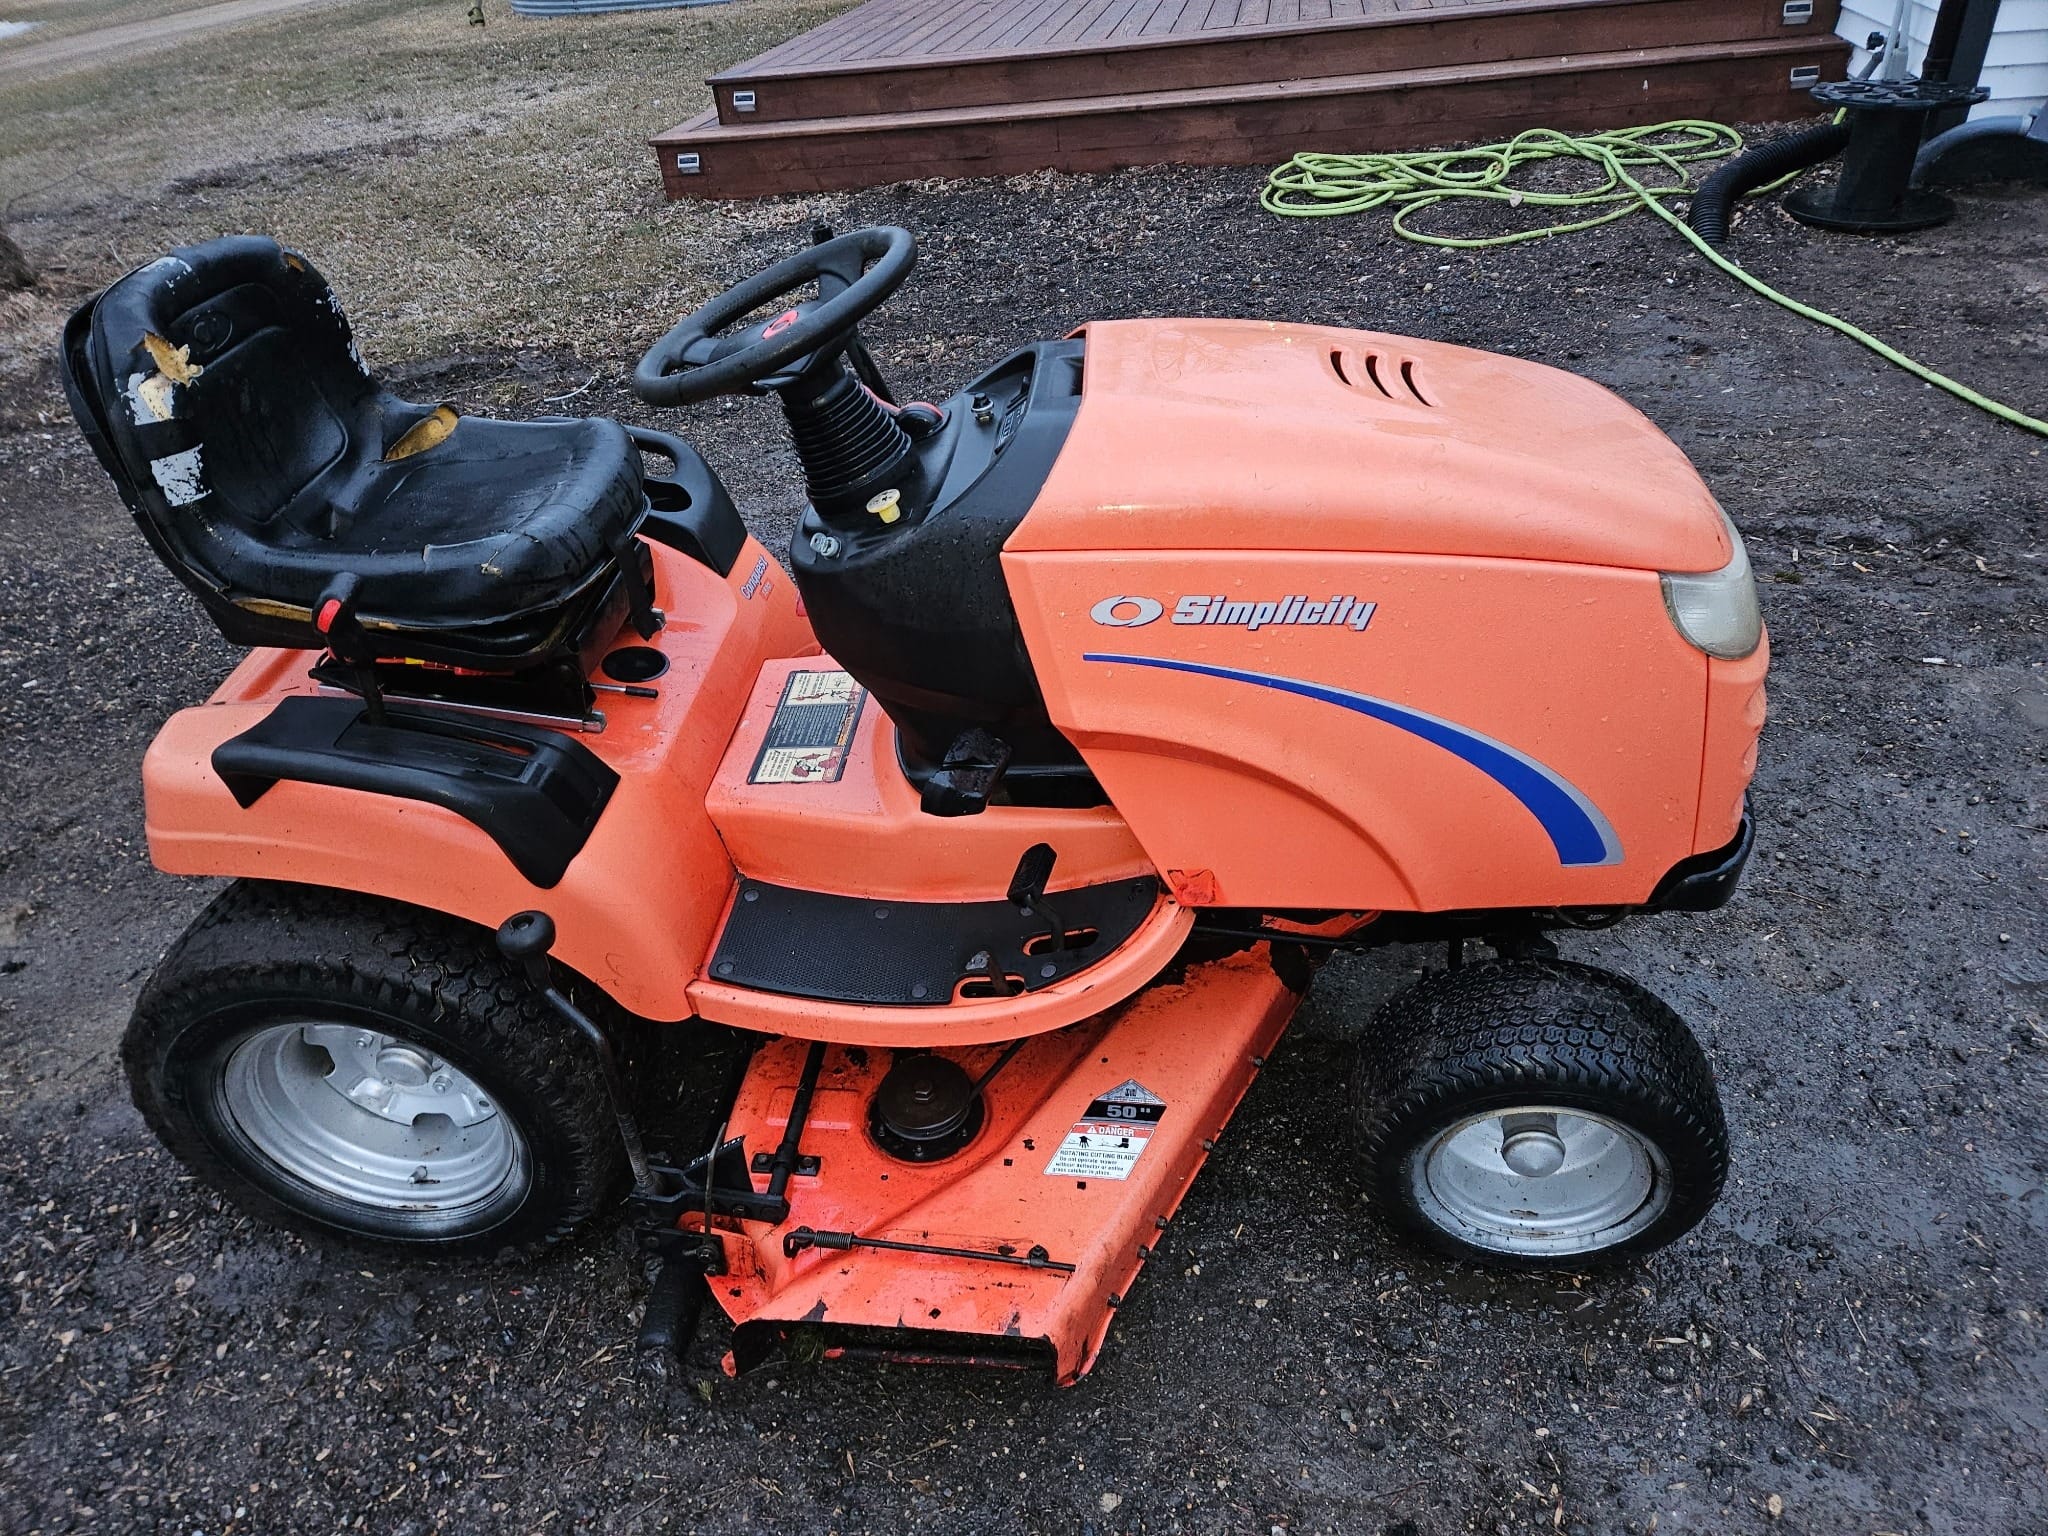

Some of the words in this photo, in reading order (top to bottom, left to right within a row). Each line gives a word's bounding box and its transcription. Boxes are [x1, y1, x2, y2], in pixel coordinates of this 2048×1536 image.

[740, 554, 768, 600] Conquest
[1171, 595, 1378, 631] Simplicity
[1106, 1104, 1151, 1119] 50"
[1098, 1126, 1134, 1137] DANGER
[1090, 1151, 1115, 1159] CUTTING
